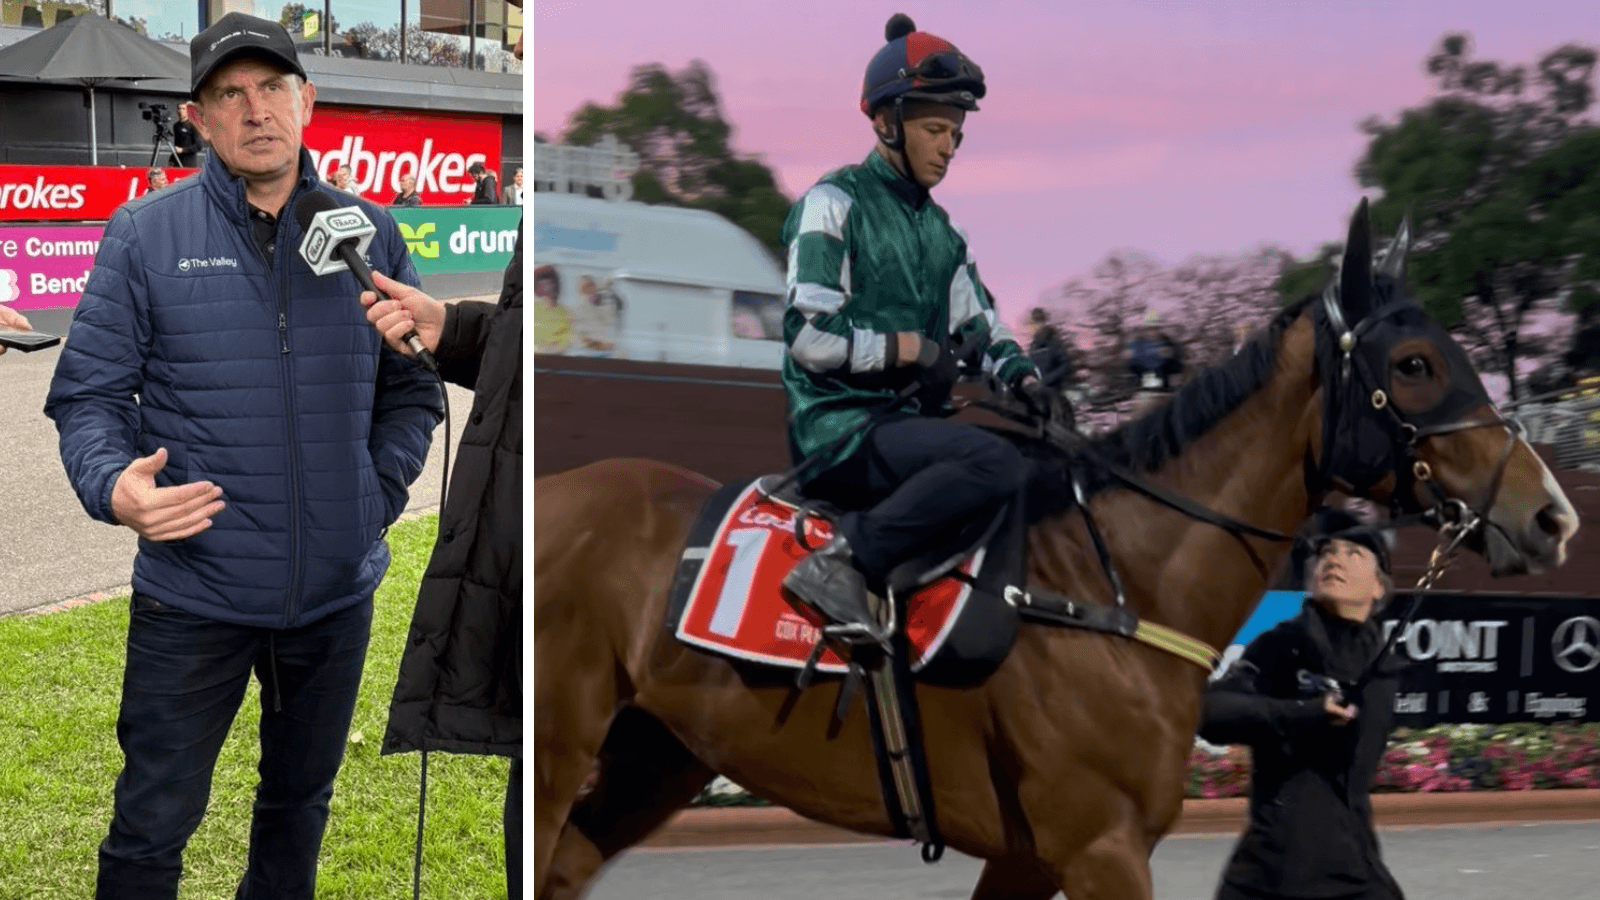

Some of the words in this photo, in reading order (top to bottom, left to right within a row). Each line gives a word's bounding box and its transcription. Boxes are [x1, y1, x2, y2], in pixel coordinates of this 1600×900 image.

[0, 175, 87, 210] rokes
[190, 258, 207, 268] The
[208, 256, 238, 268] Valley
[709, 527, 771, 638] 1
